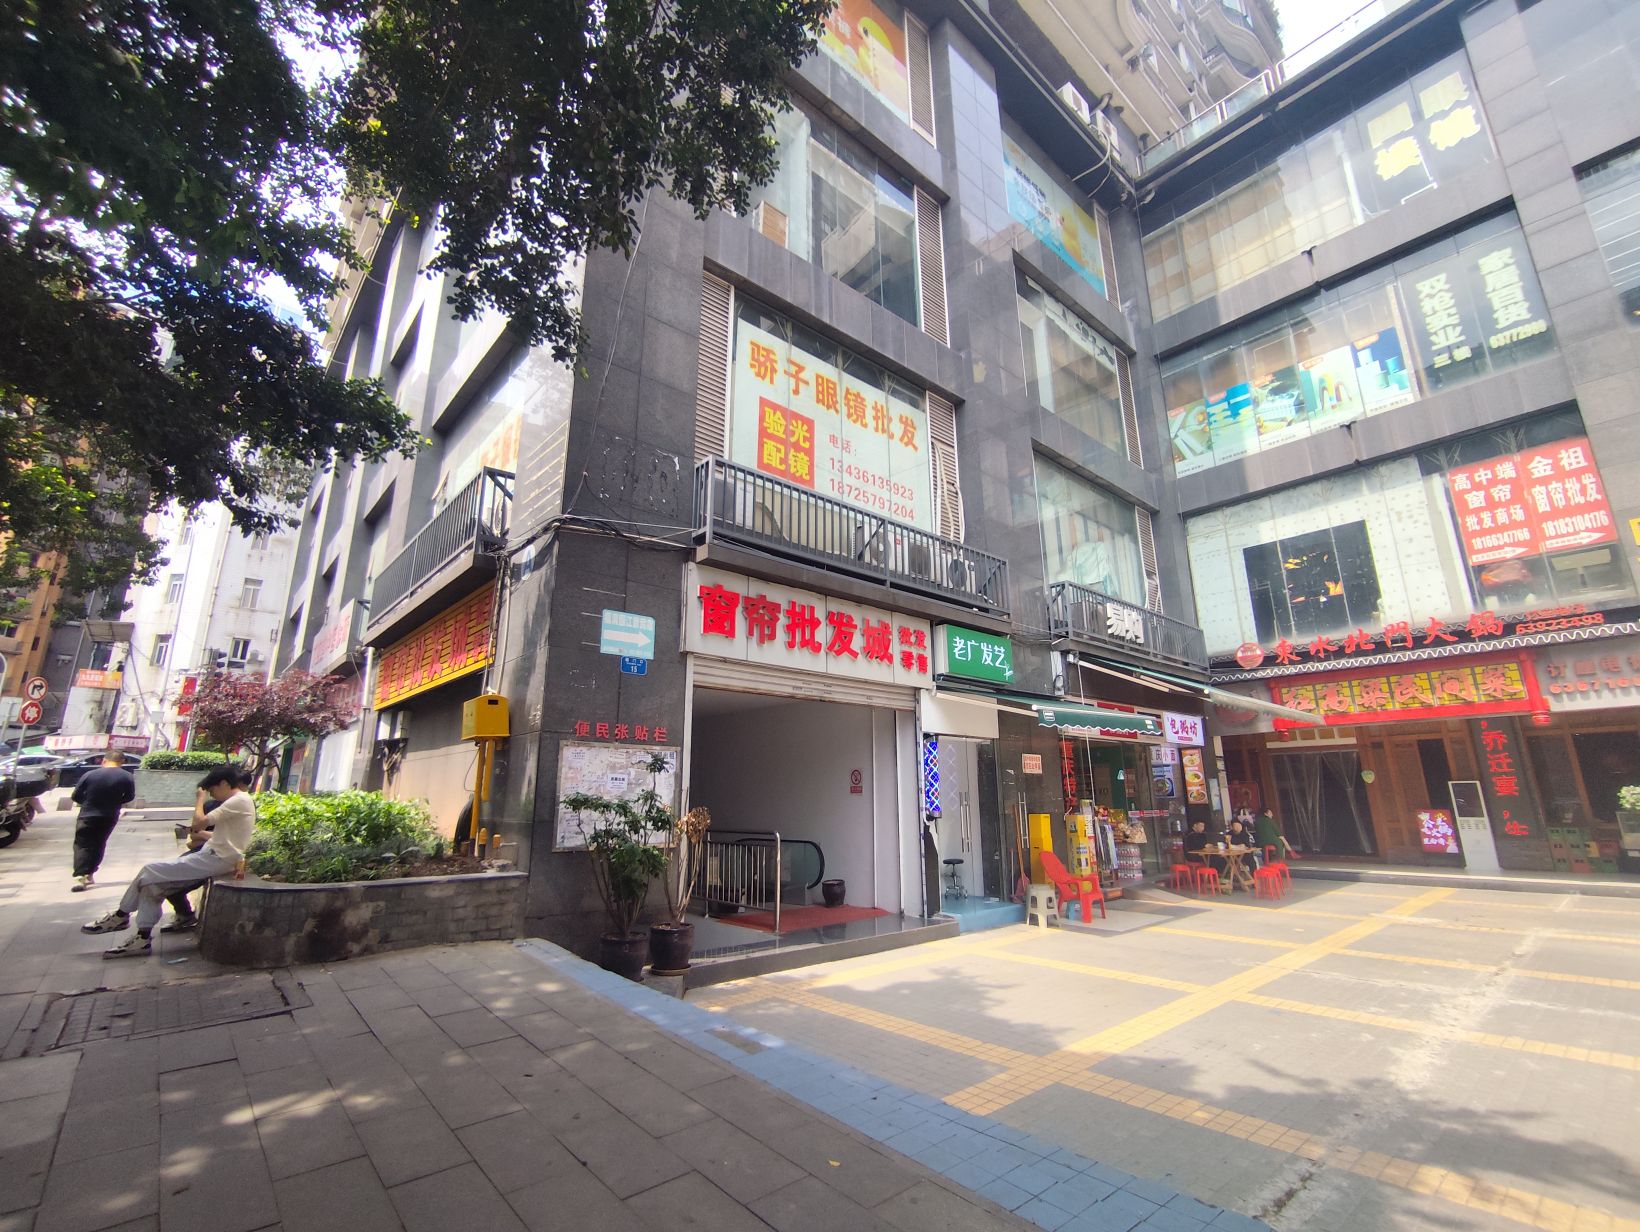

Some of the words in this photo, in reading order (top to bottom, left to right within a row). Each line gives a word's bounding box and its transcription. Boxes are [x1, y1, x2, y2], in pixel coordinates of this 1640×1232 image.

[750, 340, 919, 452] 骄子眼镜批发
[764, 406, 811, 449] 验光
[763, 438, 811, 481] 配镜
[830, 457, 913, 501] 13436135923
[1452, 461, 1517, 491] 高中端
[1527, 446, 1588, 479] 金祖
[830, 478, 914, 520] 18725797204
[1464, 485, 1512, 509] 窗帘
[1531, 473, 1601, 513] 窗帘批发
[1465, 504, 1525, 532] 批发商场
[698, 584, 894, 666] 窗帘批发城
[899, 625, 928, 650] 批发
[1106, 602, 1144, 644] 易购
[630, 665, 638, 673] 15
[900, 650, 929, 674] 零售
[952, 635, 1014, 680] 老广发艺
[575, 720, 668, 742] 便民张贴栏
